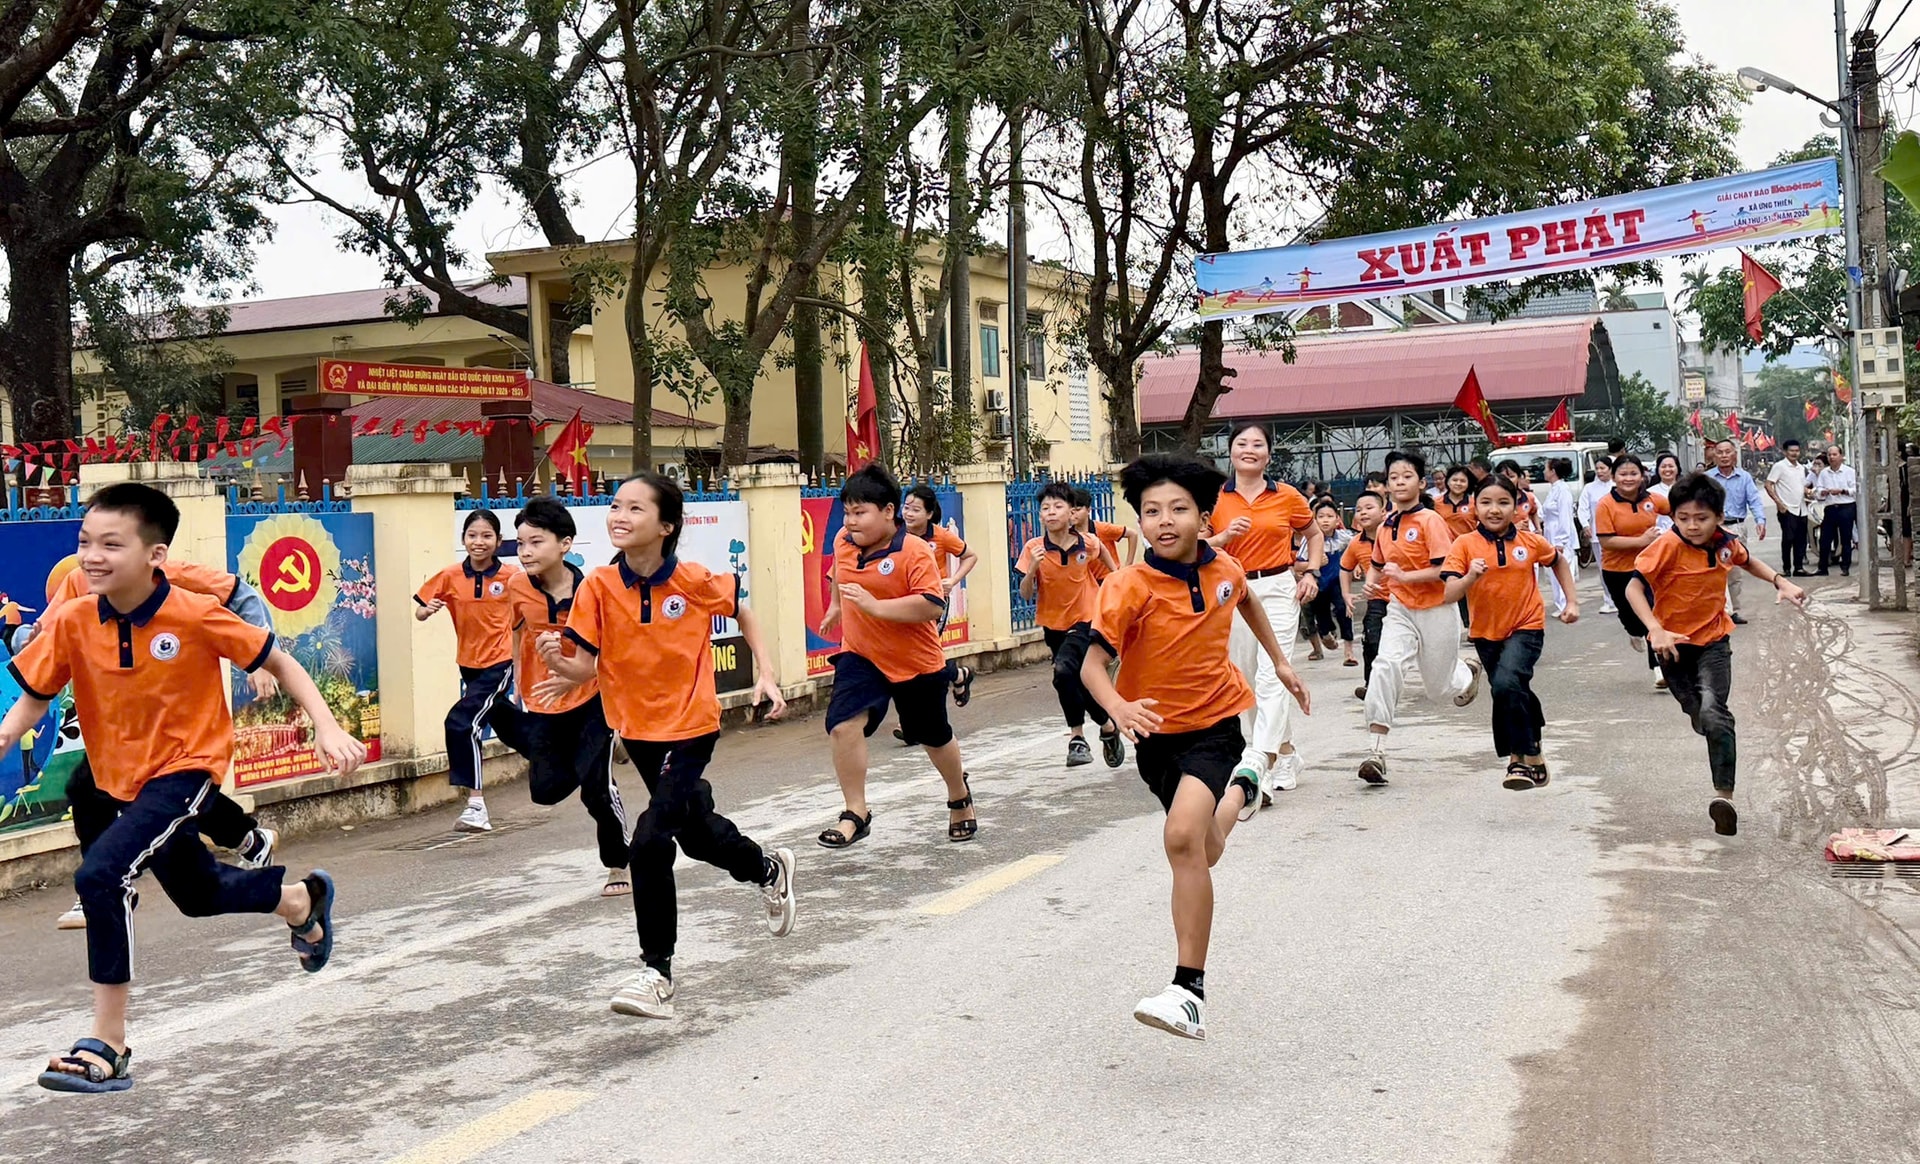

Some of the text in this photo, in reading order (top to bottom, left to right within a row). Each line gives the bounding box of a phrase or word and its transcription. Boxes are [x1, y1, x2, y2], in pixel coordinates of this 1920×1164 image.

[1717, 193, 1732, 202] GIẢI
[1734, 191, 1753, 201] CHẠY
[1754, 188, 1770, 197] BÁO
[1734, 217, 1747, 227] LẦN
[1778, 211, 1793, 220] NĂM
[1358, 208, 1645, 282] XUẤT PHÁT
[368, 367, 385, 378] NHIỆT
[386, 367, 398, 379] LIỆT
[399, 369, 414, 378] CHÀO
[357, 379, 365, 389] VÀ
[366, 381, 376, 391] ĐẠI
[378, 380, 391, 391] BIỂU
[392, 381, 401, 392] HỘI
[402, 381, 418, 392] ĐỒNG
[419, 383, 434, 393] NHÂN
[447, 384, 458, 393] CÁC
[460, 384, 470, 394] CẤP
[254, 759, 274, 771] QUANG
